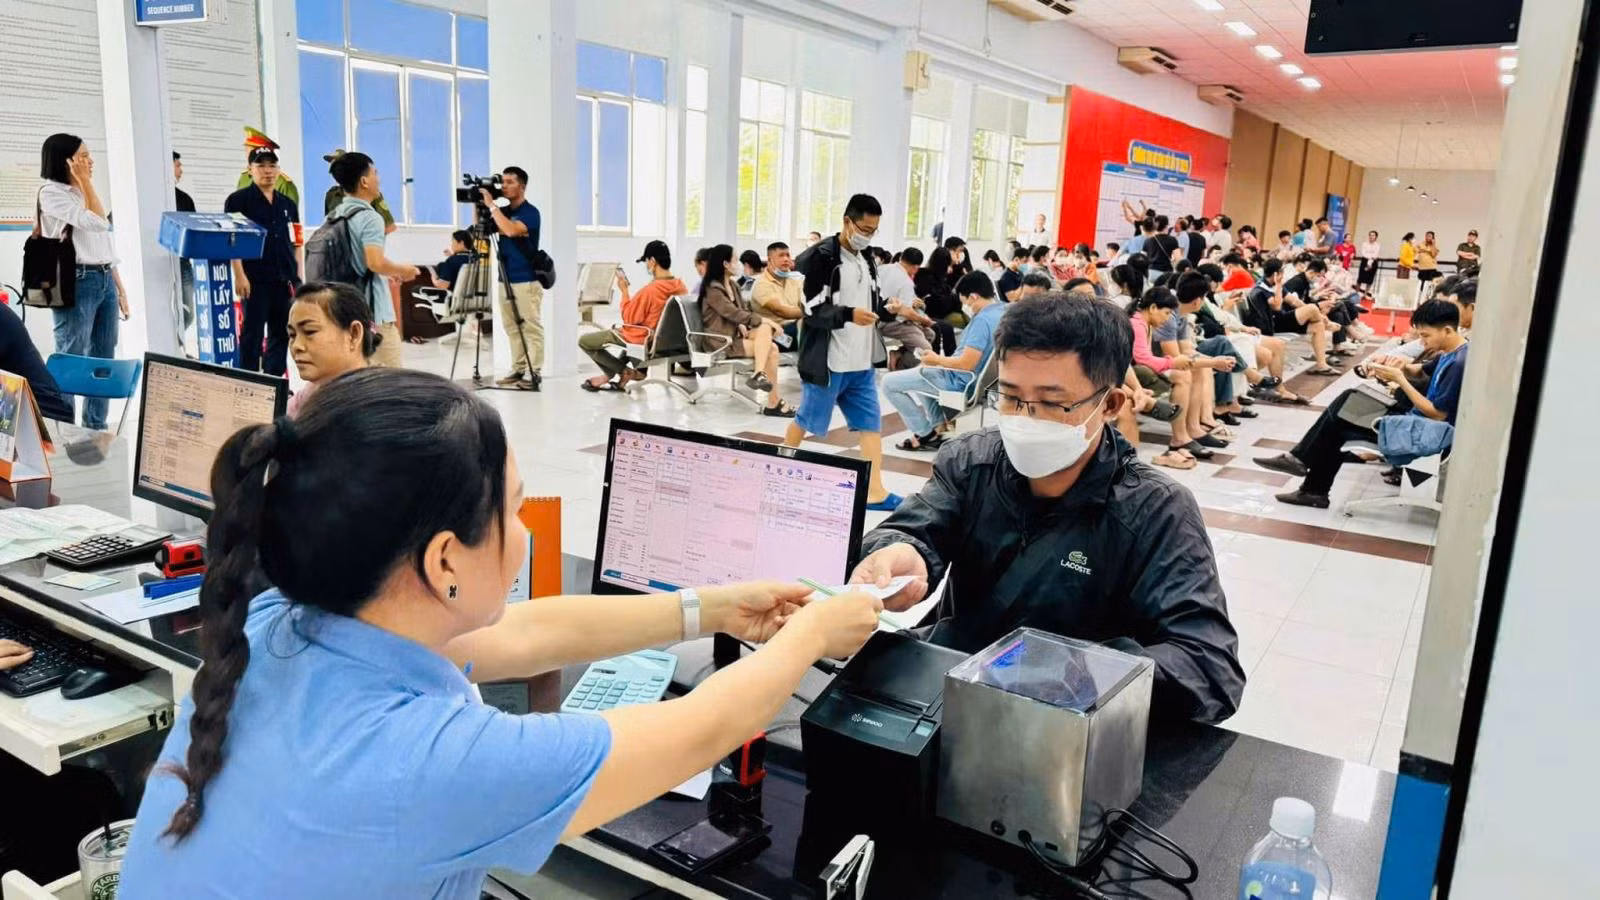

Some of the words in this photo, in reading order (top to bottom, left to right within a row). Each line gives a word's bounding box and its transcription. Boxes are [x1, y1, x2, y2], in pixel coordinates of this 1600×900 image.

[147, 5, 172, 15] SEQUENCE
[212, 264, 228, 281] NƠI
[213, 284, 230, 305] LẤY
[218, 308, 230, 329] SỐ
[217, 334, 235, 353] THỨ
[1060, 558, 1092, 575] LACOSTE
[93, 874, 120, 894] STARB
